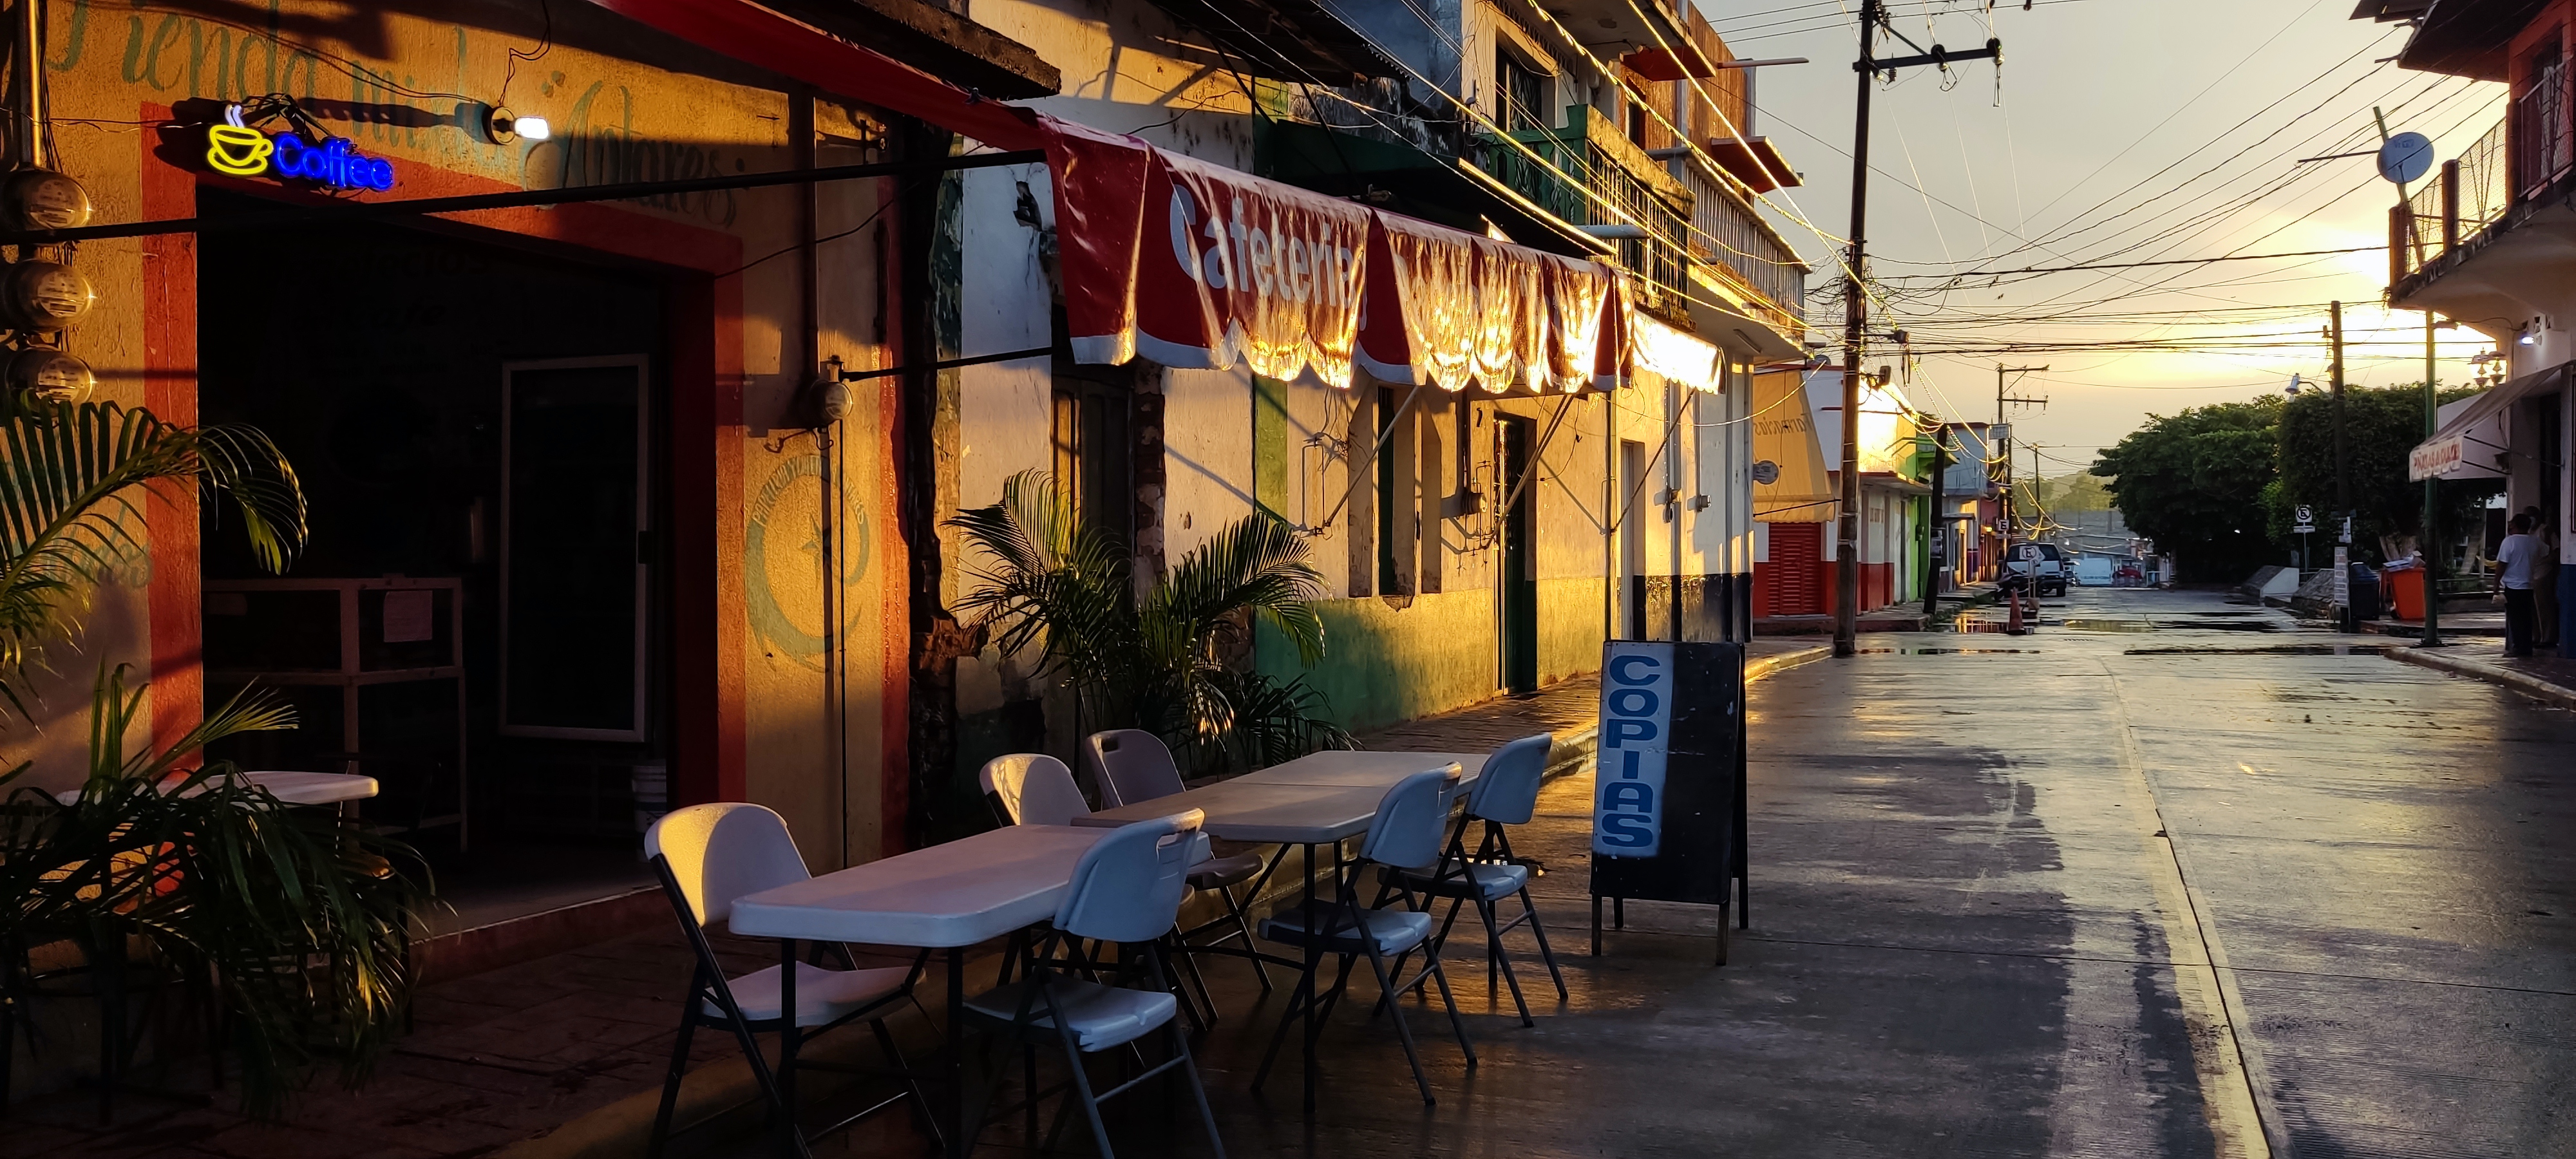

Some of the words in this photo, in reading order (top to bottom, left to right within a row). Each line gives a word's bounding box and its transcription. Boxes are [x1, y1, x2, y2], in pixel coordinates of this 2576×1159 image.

[273, 131, 393, 191] Coffee
[1170, 184, 1368, 325] Cafeteria
[2000, 521, 2007, 529] E
[1601, 655, 1661, 847] COPIAS
